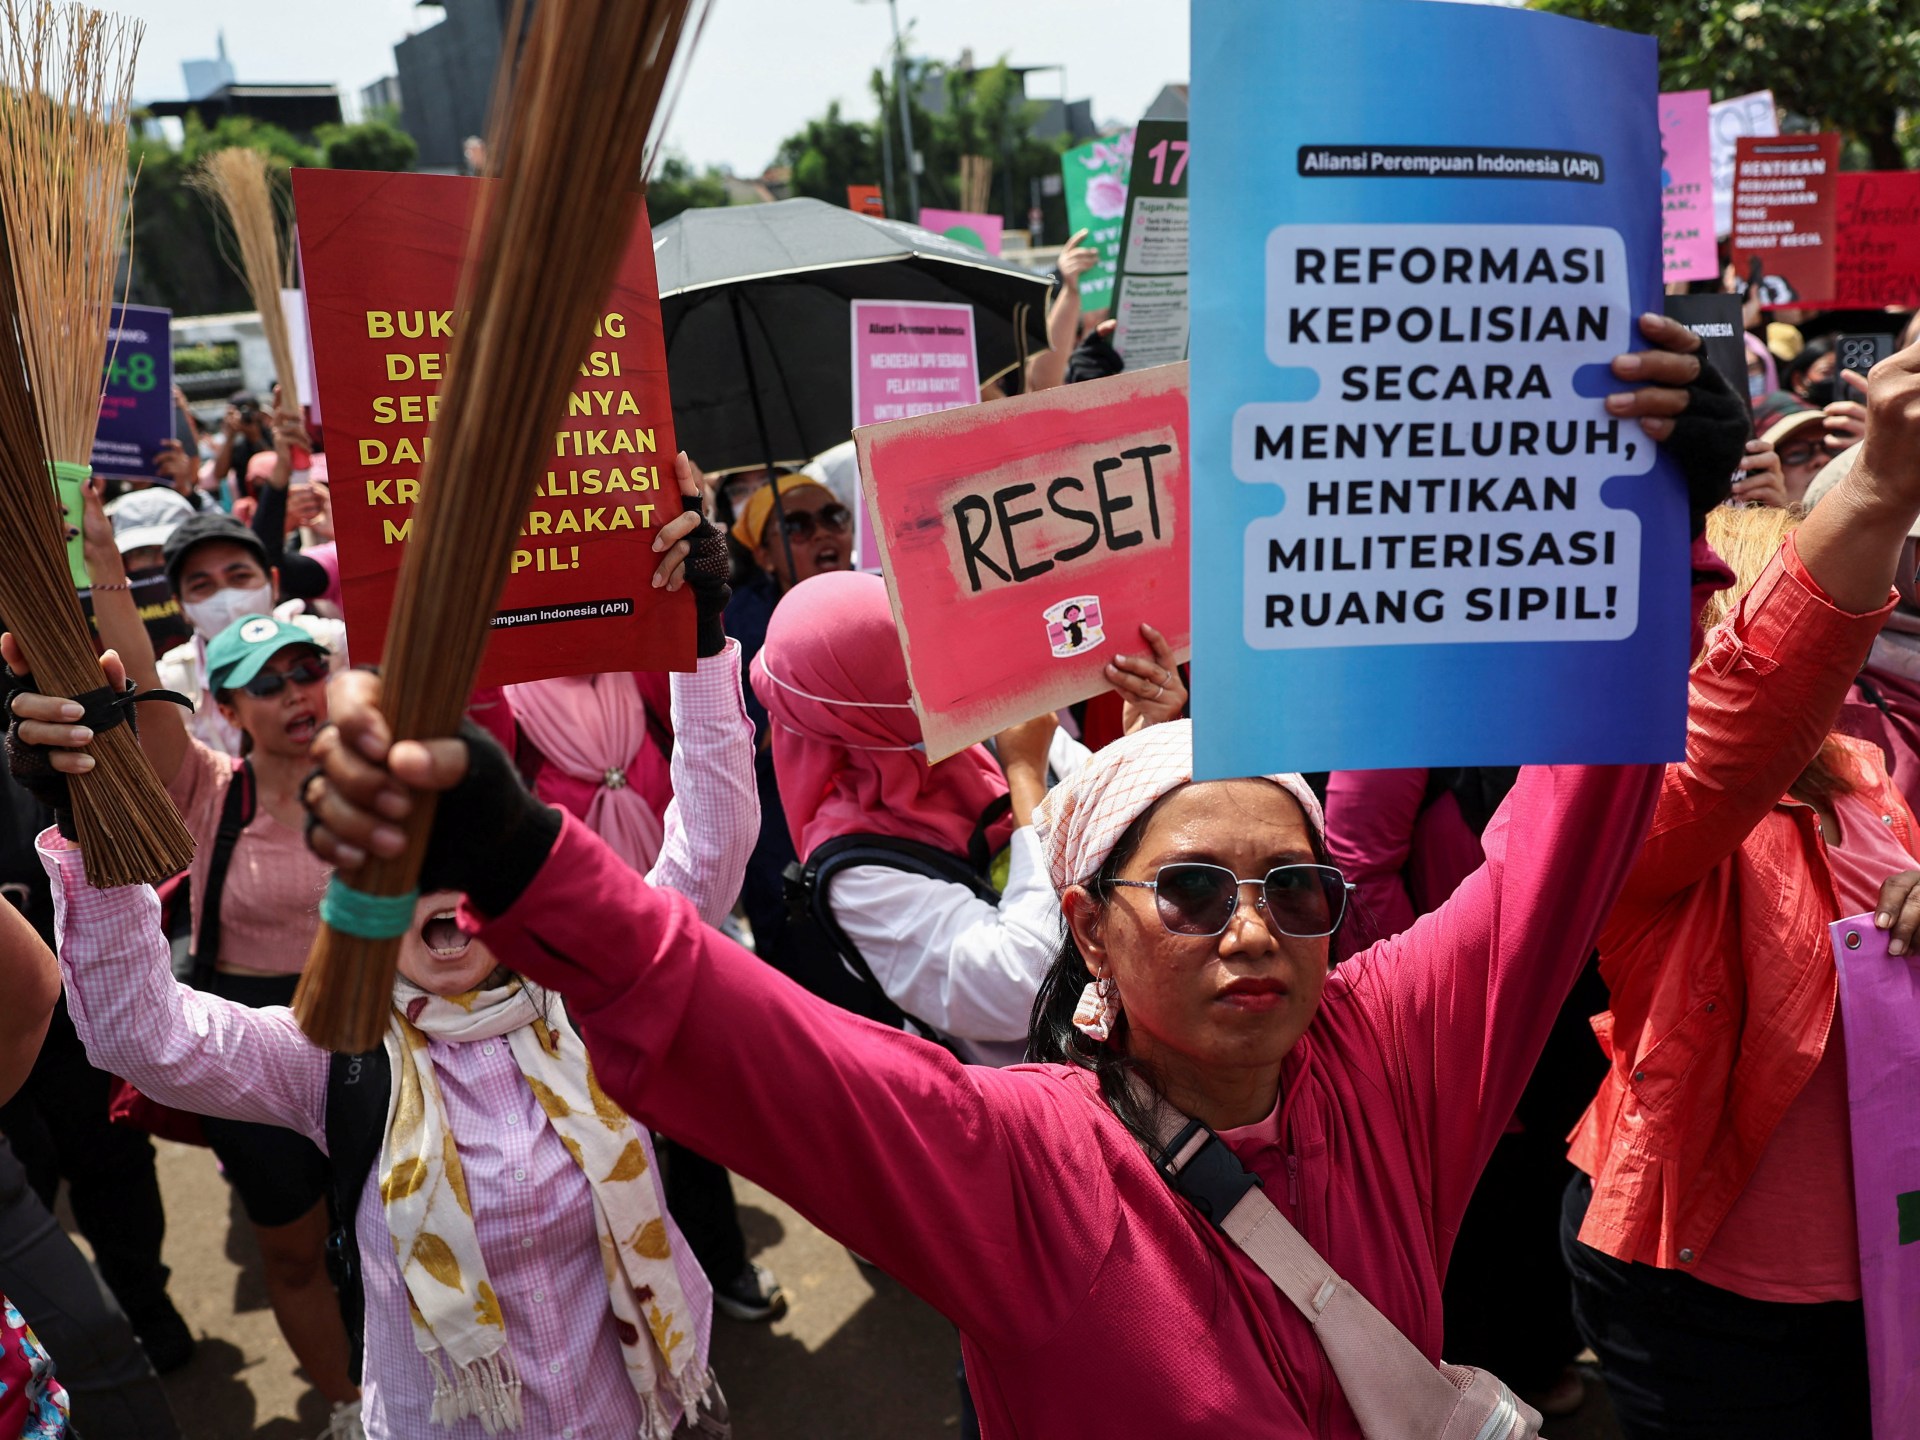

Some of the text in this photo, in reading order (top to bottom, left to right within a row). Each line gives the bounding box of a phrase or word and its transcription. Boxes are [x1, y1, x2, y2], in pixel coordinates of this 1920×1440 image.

[1304, 152, 1600, 181] Aliansi Perempuan Indonesia (API)
[1296, 247, 1605, 284] REFORMASI
[366, 311, 456, 339] BUK
[1288, 305, 1610, 343] KEPOLISIAN
[1341, 364, 1551, 402] SECARA
[1254, 419, 1638, 462] MENYELURUH,
[1307, 476, 1577, 517] HENTIKAN
[952, 444, 1172, 592] RESET
[510, 545, 580, 575] PIL!
[1268, 531, 1616, 573] MILITERISASI
[489, 601, 630, 627] empuan Indonesia (API)
[1265, 586, 1618, 628] RUANG SIPIL!
